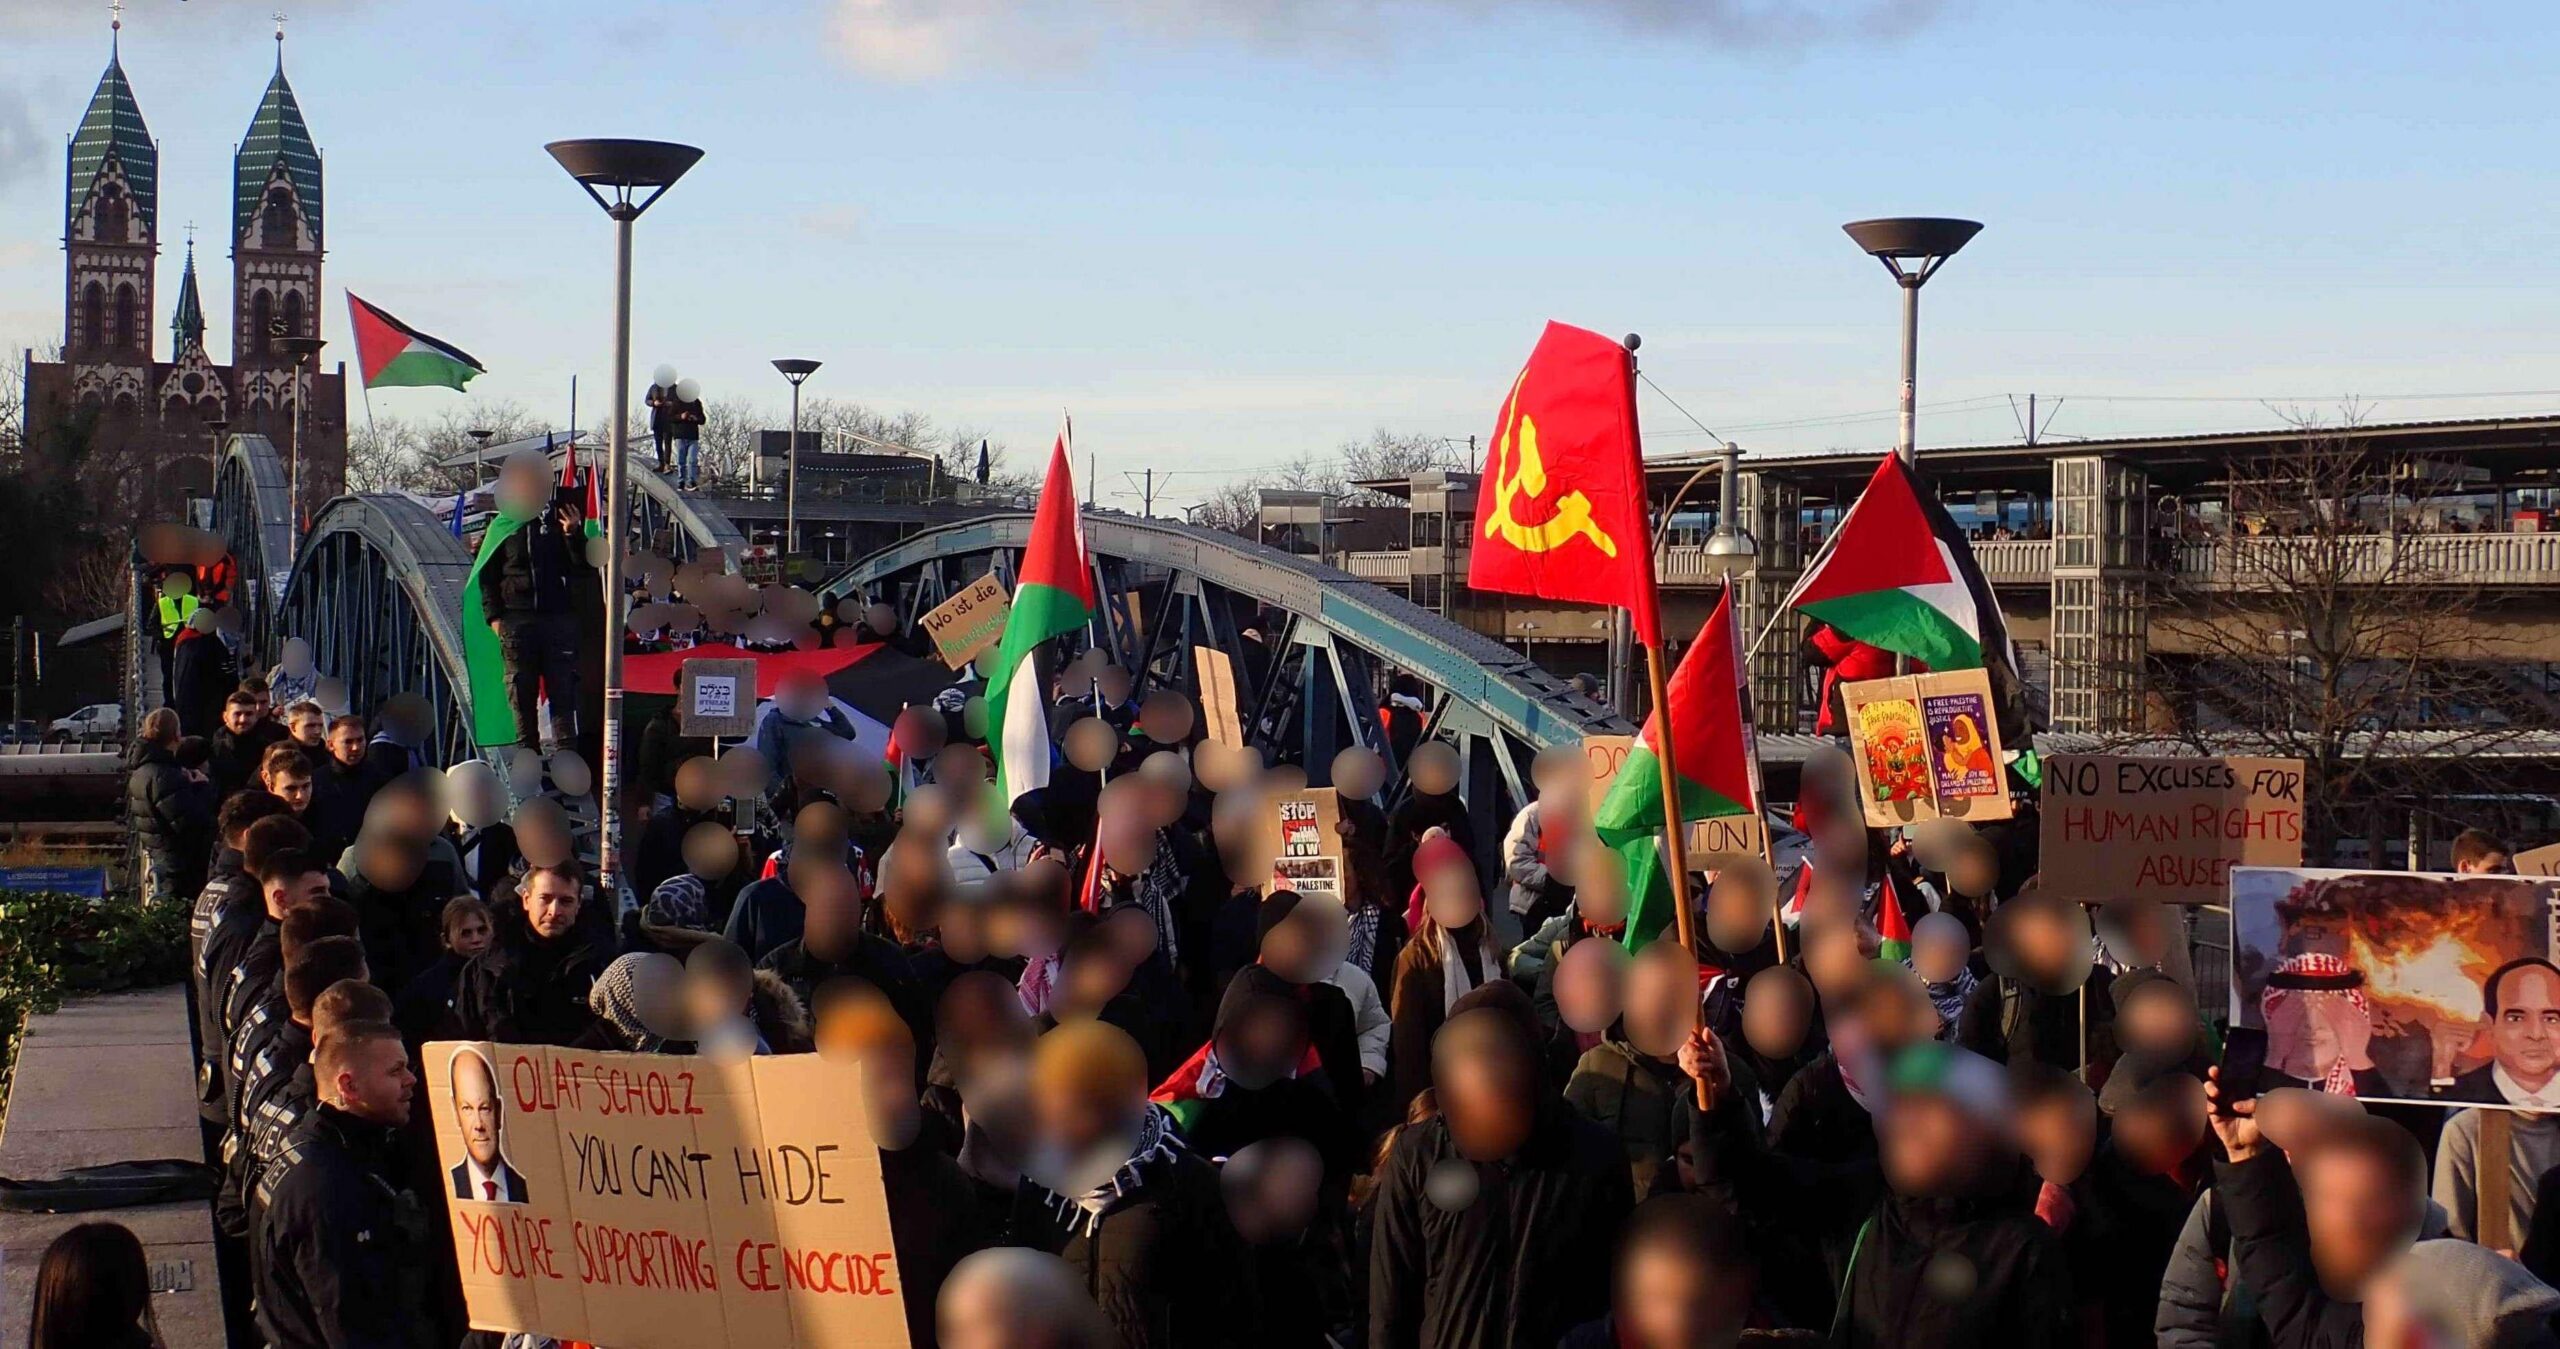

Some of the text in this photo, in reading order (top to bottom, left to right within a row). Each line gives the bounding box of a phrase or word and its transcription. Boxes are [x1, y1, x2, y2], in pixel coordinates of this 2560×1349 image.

[927, 585, 997, 631] Wo ist die
[1927, 708, 1934, 716] IS
[1934, 705, 1973, 715] REPRODUCTIVE
[1933, 698, 1949, 707] FREE
[1949, 696, 1978, 706] PALESTINE
[1929, 715, 1951, 726] JUSTICE
[2051, 762, 2299, 802] NO EXCUSES FOR
[1281, 802, 1315, 820] STOP
[2065, 804, 2299, 842] HUMAN RIGHTS
[1287, 842, 1318, 856] NOW
[1690, 820, 1747, 852] TON
[1296, 880, 1334, 890] PALESTINE
[513, 1055, 704, 1115] OLAF SCHOLZ
[569, 1132, 845, 1205] YOU CAN'T HIDE
[461, 1210, 895, 1296] YOU'RE SUPPORTING GENOCIDE
